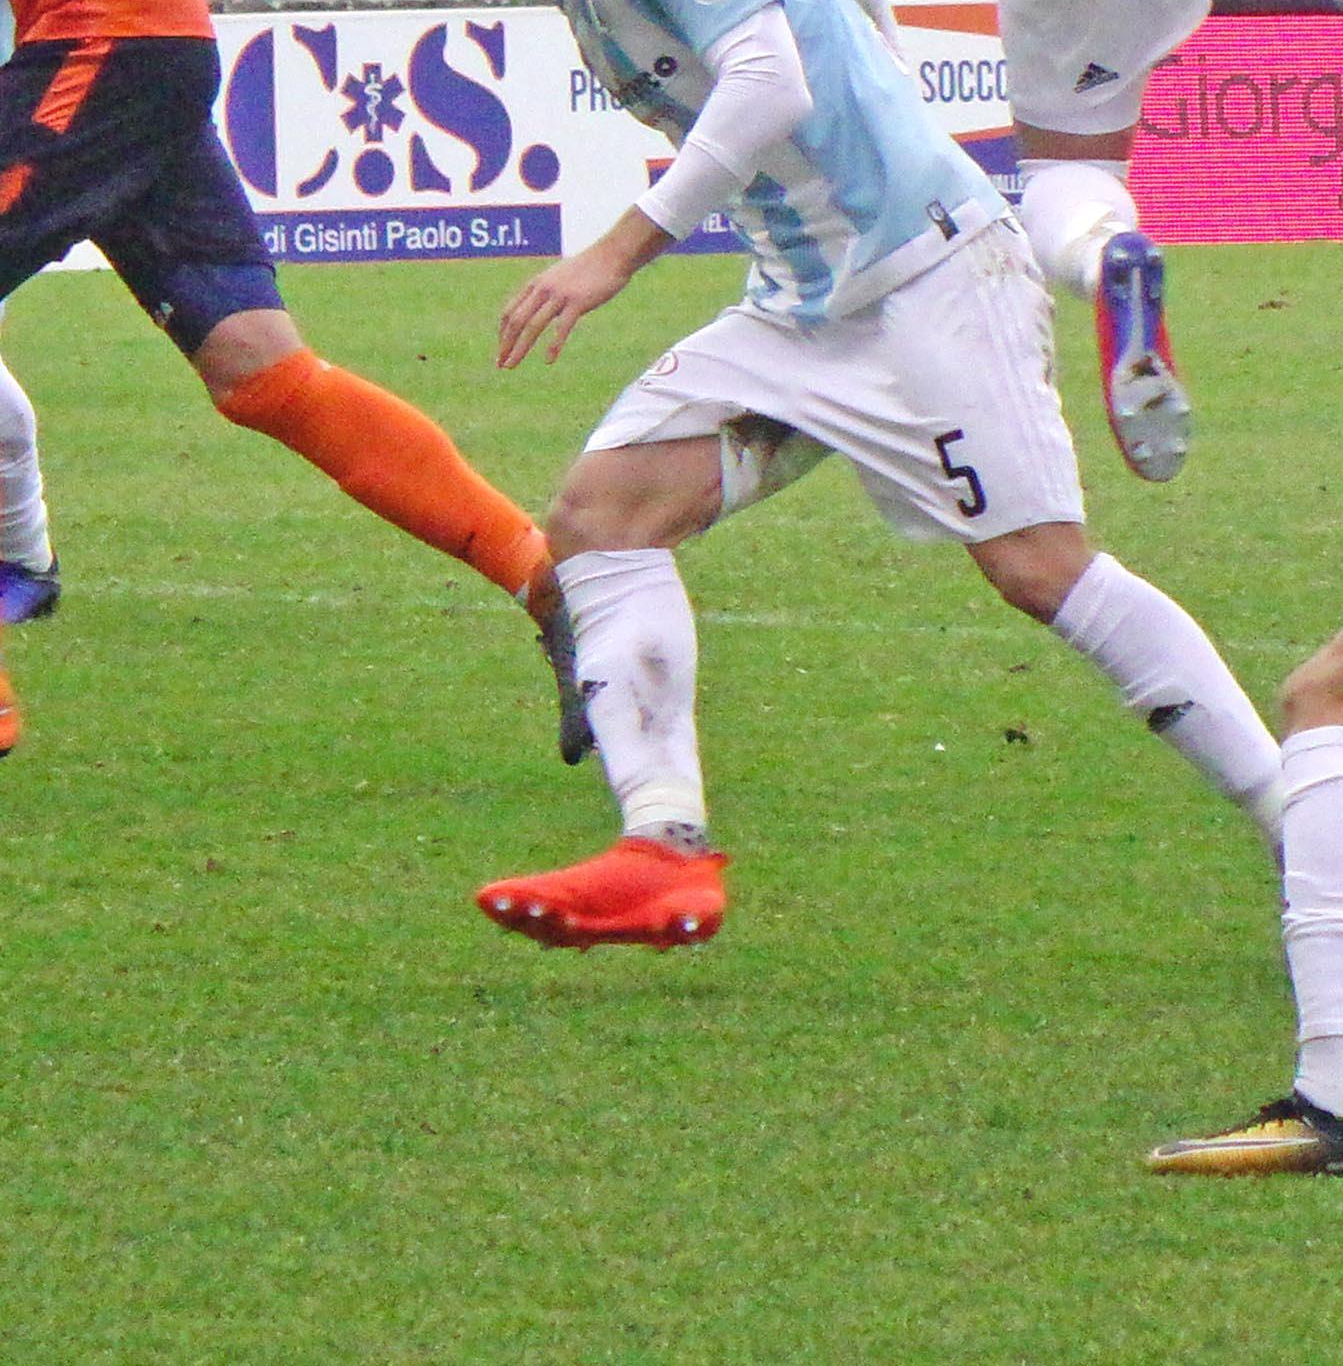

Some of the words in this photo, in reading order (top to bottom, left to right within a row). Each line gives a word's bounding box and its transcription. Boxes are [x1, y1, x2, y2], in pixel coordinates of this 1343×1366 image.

[294, 223, 378, 253] Gisinti
[387, 219, 462, 250] Paolo
[471, 217, 529, 247] S.r.l.
[934, 430, 989, 518] 5
